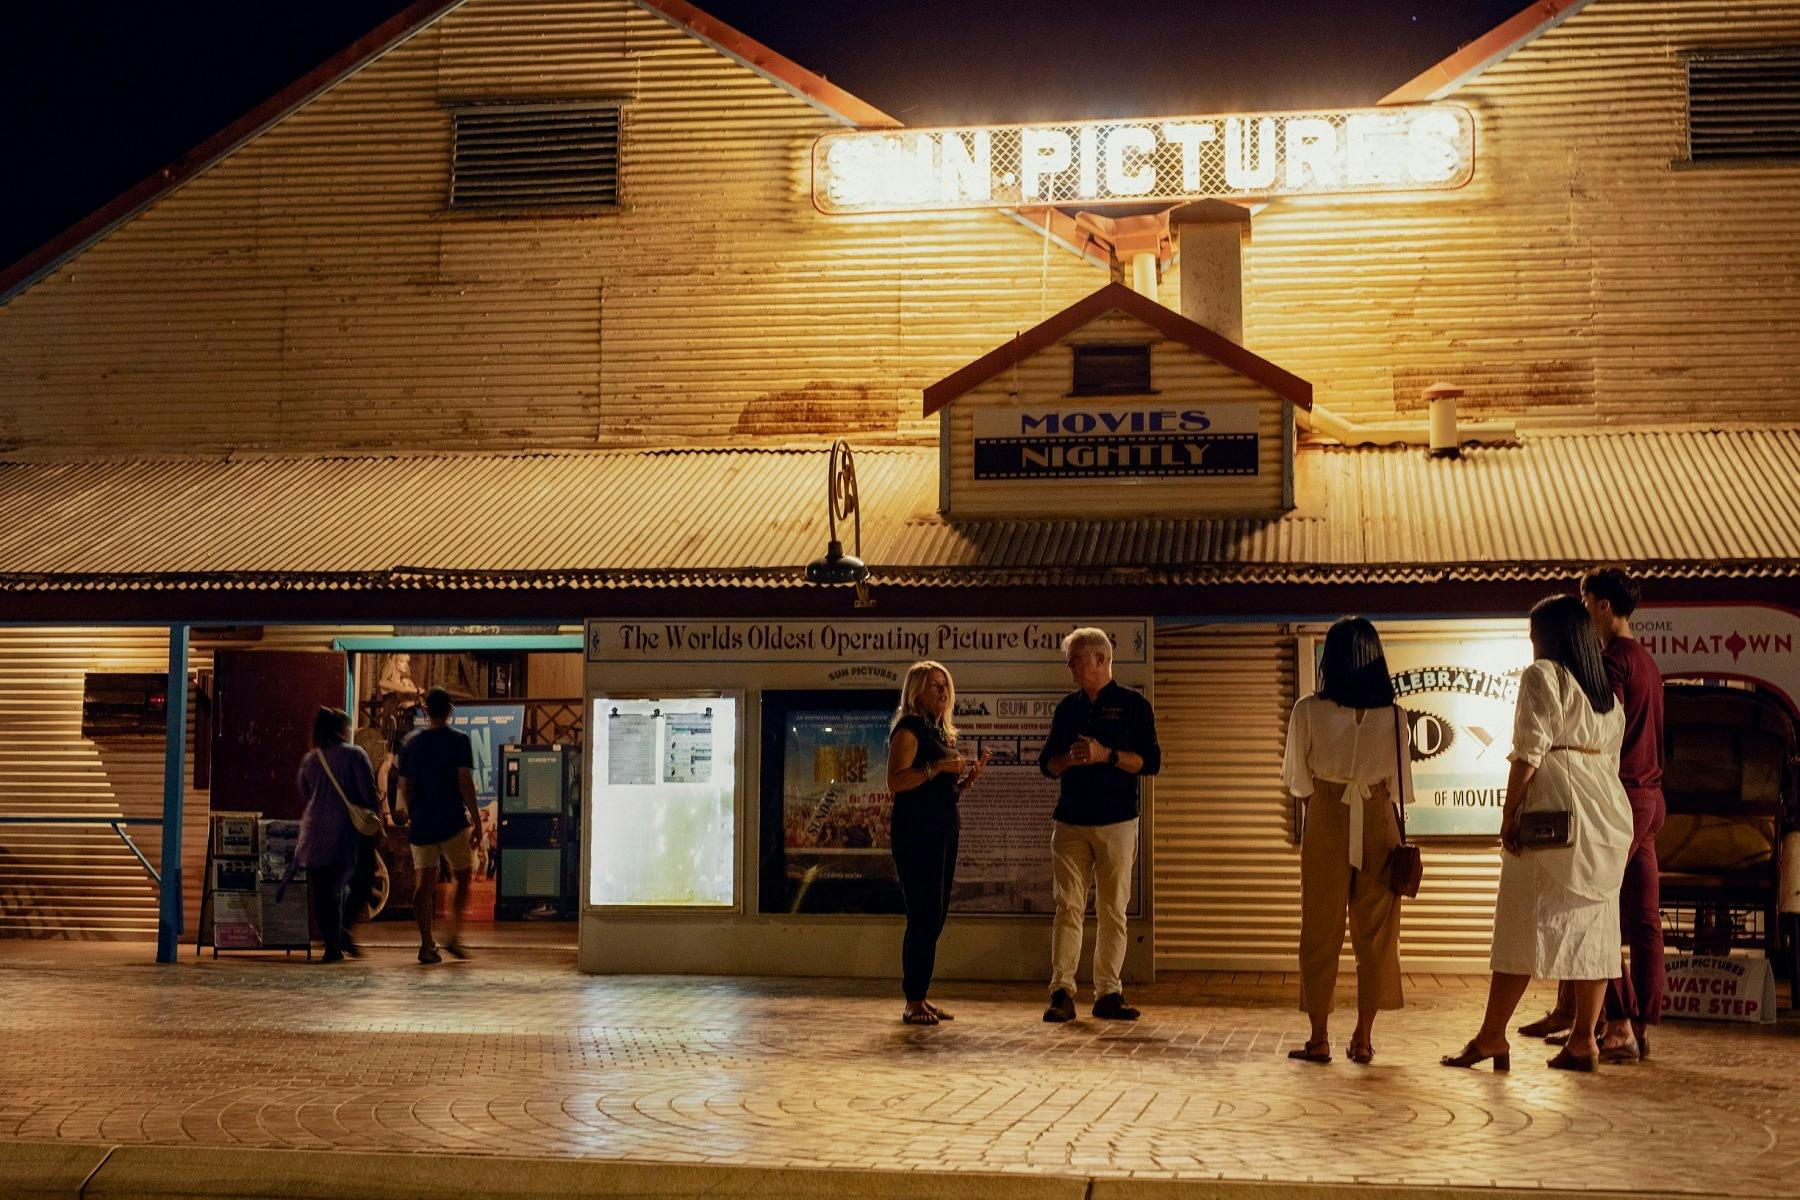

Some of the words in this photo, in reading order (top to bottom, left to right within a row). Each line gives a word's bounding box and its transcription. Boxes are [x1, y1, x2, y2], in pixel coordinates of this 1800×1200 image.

[1021, 111, 1461, 203] PICTURES
[1021, 411, 1211, 434] MOVIES
[1021, 443, 1211, 468] NIGHTLY
[1628, 621, 1673, 631] ROOME
[618, 625, 659, 654] The
[665, 625, 743, 650] Worlds
[747, 624, 815, 650] Oldest
[820, 624, 929, 656] Operating
[935, 624, 1019, 650] Picture
[999, 702, 1028, 715] SUN
[1033, 702, 1055, 715] PIC
[1434, 791, 1448, 806] OF
[1453, 789, 1507, 807] MOVIE
[1664, 960, 1689, 972] SUN
[1691, 958, 1746, 976] PICTURES
[1668, 977, 1738, 995] WATCH
[1661, 996, 1700, 1012] OUR
[1708, 998, 1758, 1016] STEP
